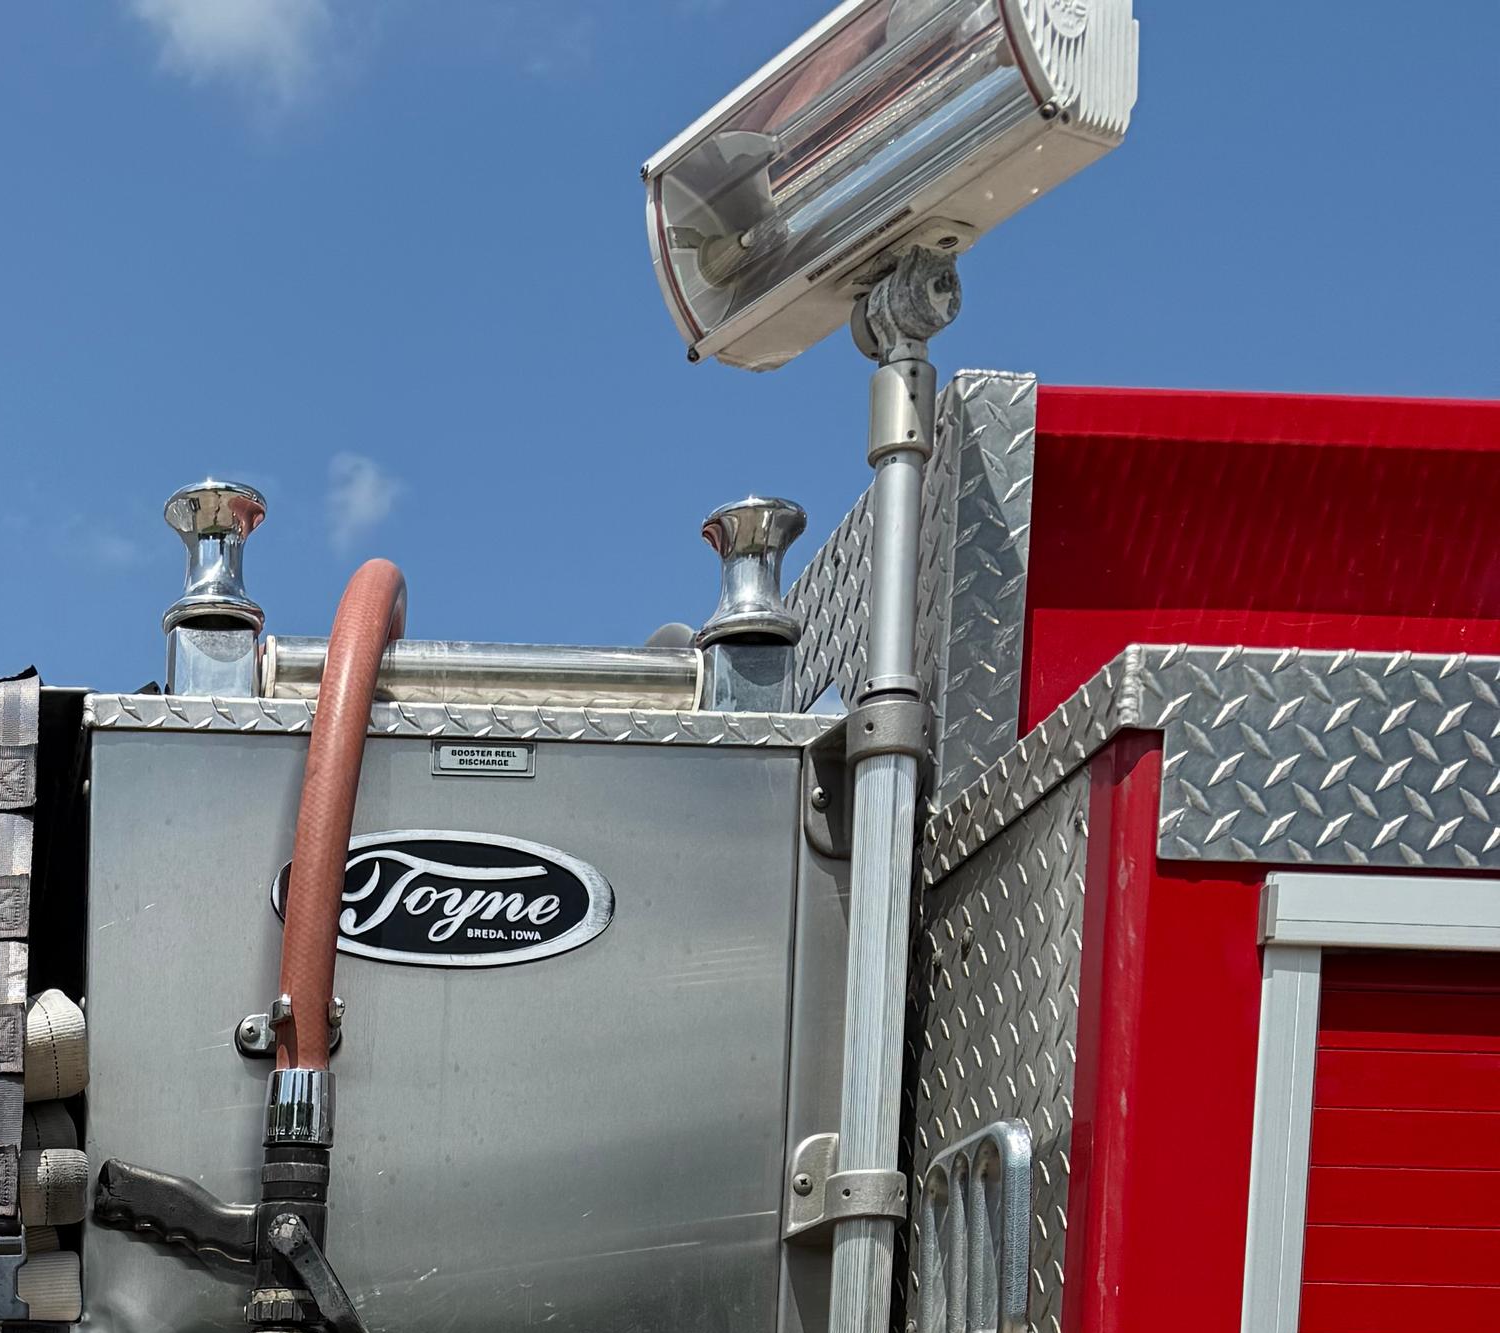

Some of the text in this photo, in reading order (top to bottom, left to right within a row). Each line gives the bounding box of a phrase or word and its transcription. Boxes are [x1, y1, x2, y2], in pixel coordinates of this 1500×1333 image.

[451, 748, 517, 758] BOOSTER REEL
[459, 758, 509, 766] DISCHARGE
[339, 850, 560, 942] Toyne
[467, 928, 542, 941] BREDA, IOWA
